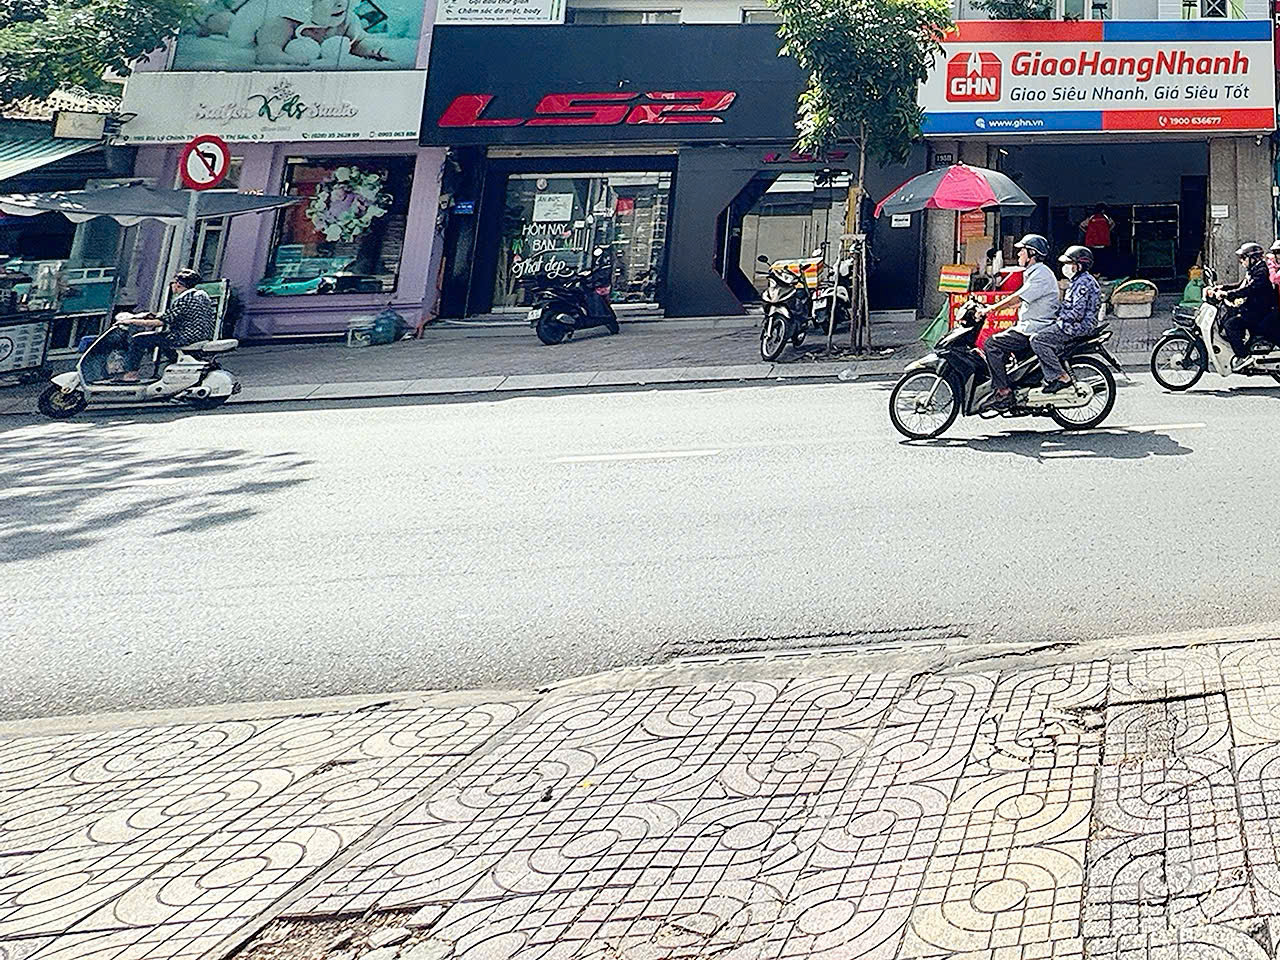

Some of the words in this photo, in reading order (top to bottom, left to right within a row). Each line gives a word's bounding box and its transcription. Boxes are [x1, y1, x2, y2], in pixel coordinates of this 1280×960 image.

[1010, 50, 1250, 82] GiaoHangNhanh
[951, 76, 996, 96] GHN
[1010, 87, 1046, 101] Giao
[1052, 86, 1086, 101] Siêu
[1092, 86, 1148, 101] Nhanh,
[1154, 85, 1179, 100] Giá
[1185, 84, 1219, 99] Siêu
[1225, 83, 1250, 99] Tốt
[437, 91, 737, 128] LS2
[988, 117, 1043, 128] www.ghn.vn
[1169, 116, 1190, 125] 1900
[548, 223, 568, 236] NAY
